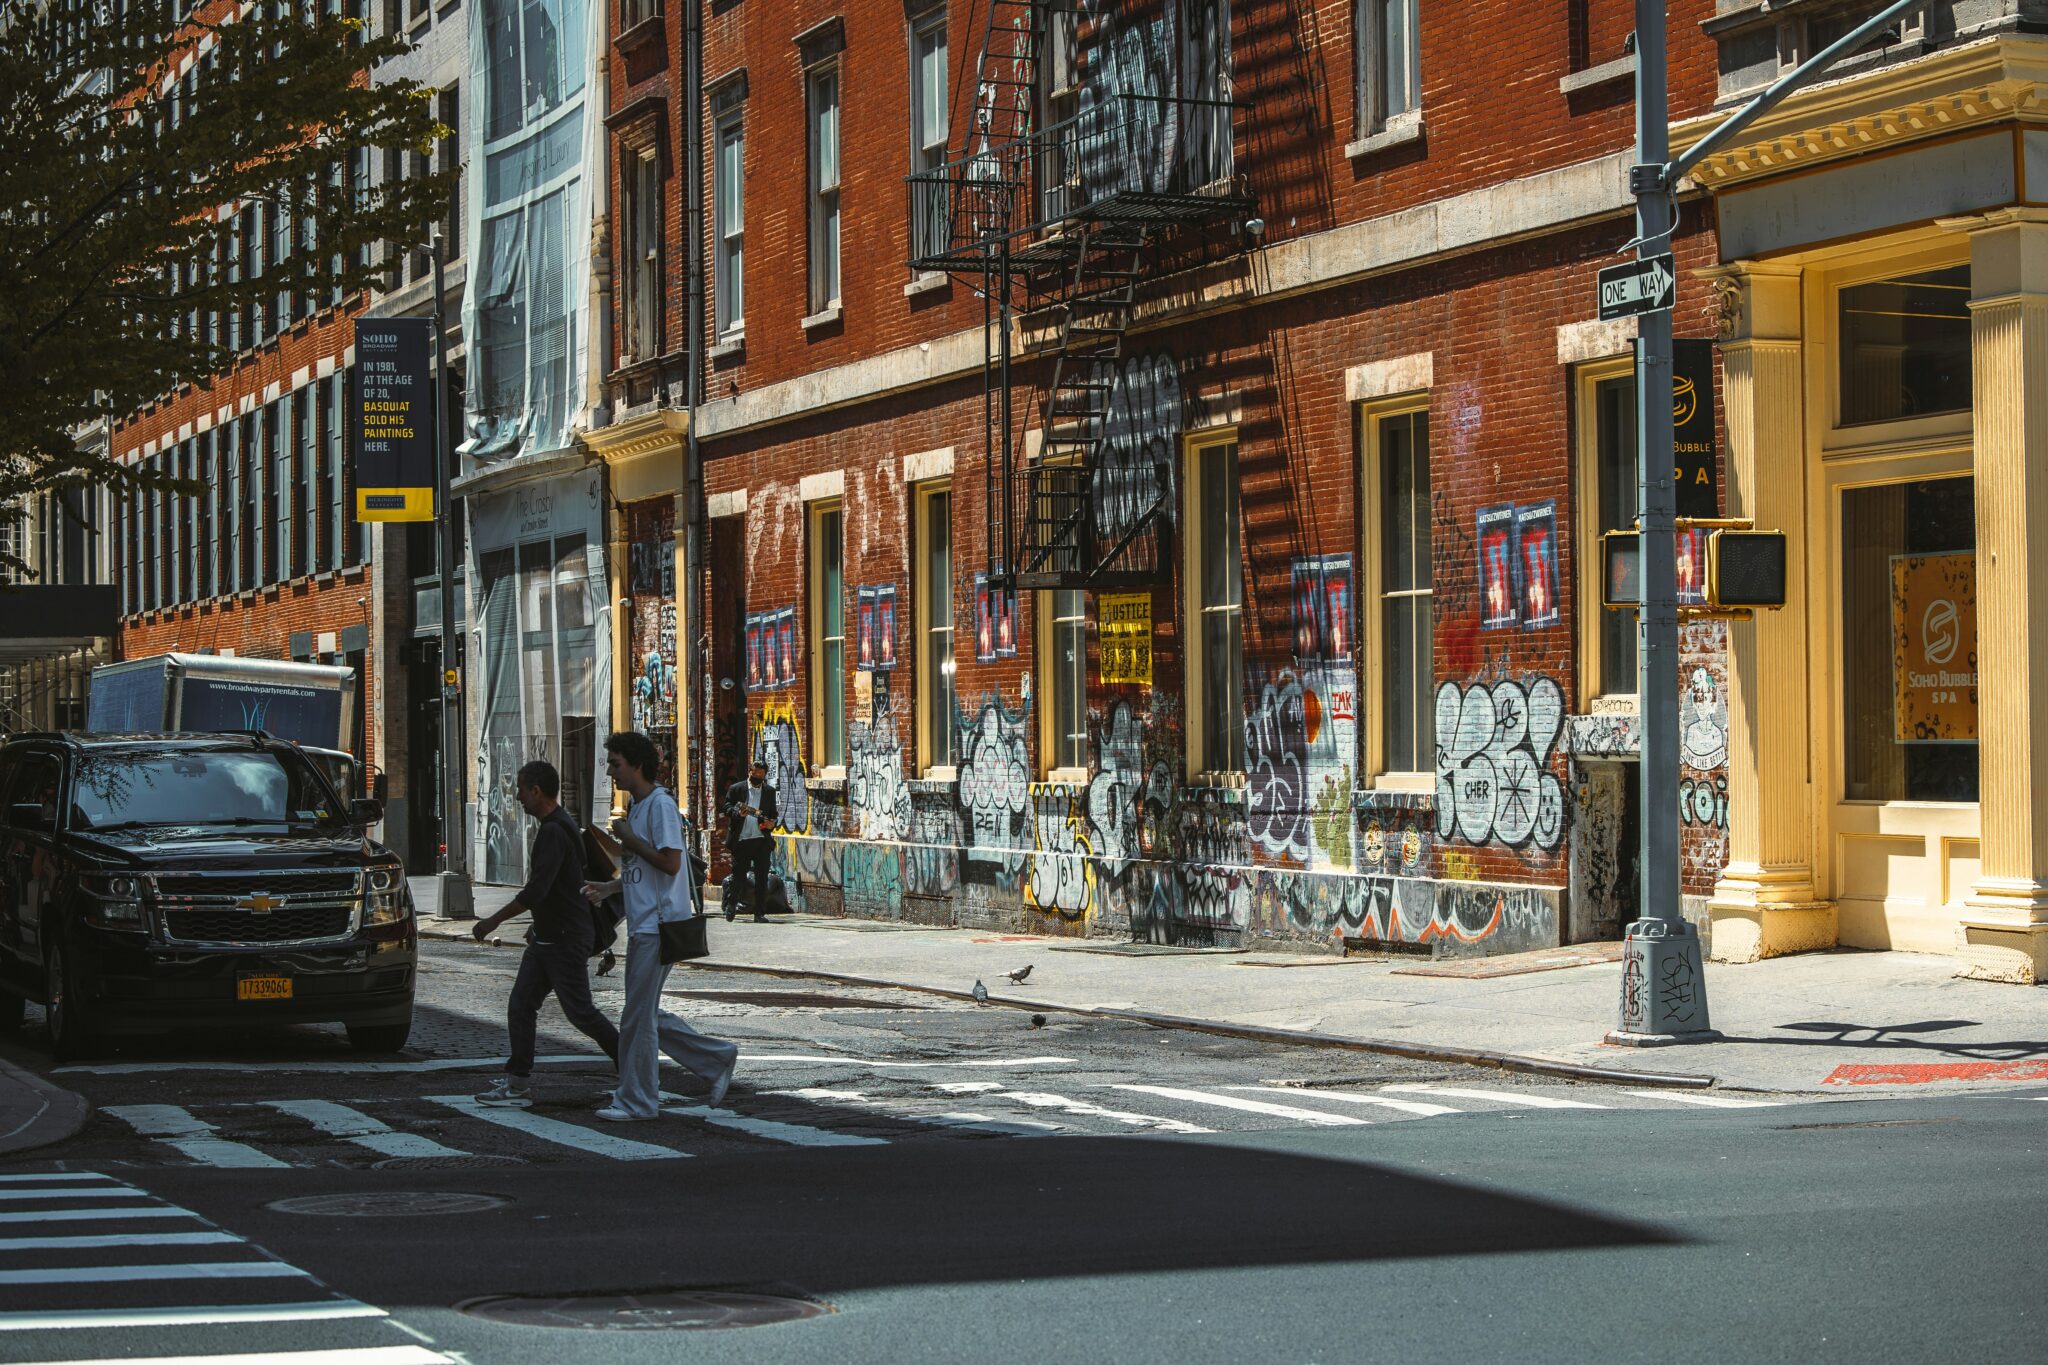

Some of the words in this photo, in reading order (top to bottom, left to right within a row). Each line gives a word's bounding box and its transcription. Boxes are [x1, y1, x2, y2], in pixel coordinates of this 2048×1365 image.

[1605, 281, 1627, 304] ONE
[1640, 273, 1664, 297] WAY
[363, 334, 398, 343] SOHO
[363, 362, 374, 372] IN
[376, 361, 397, 373] 1981,
[363, 375, 374, 385] AT
[376, 375, 393, 385] THE
[395, 375, 413, 385] AGE
[363, 388, 375, 398] OF
[377, 388, 390, 399] 20,
[364, 401, 410, 412] BASQUIAT
[364, 415, 387, 425] SOLD
[389, 415, 405, 425] HIS
[364, 428, 414, 438] PAINTINGS
[364, 441, 390, 452] HERE.
[1673, 441, 1711, 452] BUBBLE
[515, 489, 529, 520] The
[530, 483, 553, 518] Crosby
[209, 682, 316, 697] www.broadwaypartyrentals.com
[1932, 691, 1957, 704] SPA
[1697, 758, 1708, 768] LIKE
[1465, 780, 1489, 799] CHER
[1624, 949, 1645, 963] KILLER
[242, 980, 288, 994] T733906C
